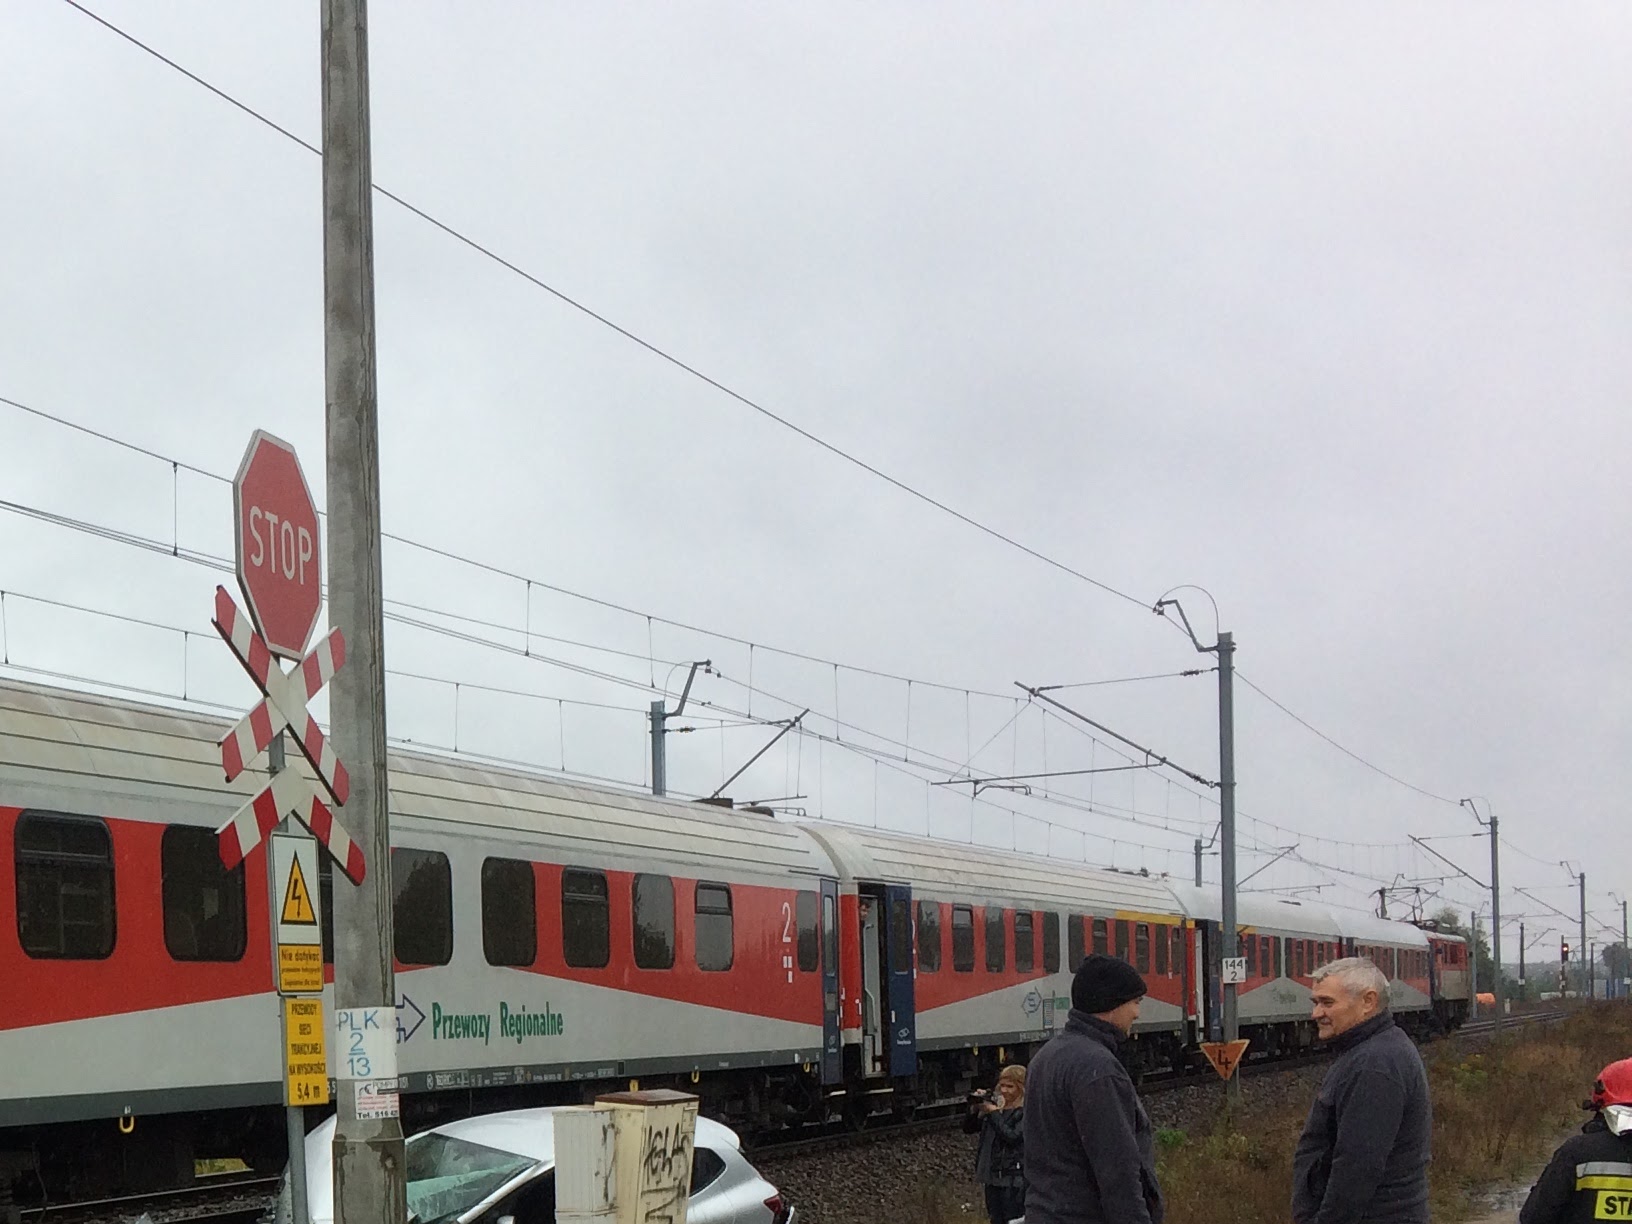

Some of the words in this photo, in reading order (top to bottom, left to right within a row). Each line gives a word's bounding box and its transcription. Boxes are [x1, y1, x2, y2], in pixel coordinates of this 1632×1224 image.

[249, 505, 312, 585] STOP
[782, 902, 792, 942] 2
[1225, 959, 1243, 970] 144
[1231, 971, 1238, 981] 2
[337, 1010, 379, 1031] PLK
[432, 1002, 490, 1046] Przewozy
[500, 1001, 563, 1044] Regionalne
[349, 1032, 364, 1052] 2
[347, 1057, 371, 1077] 13
[297, 1082, 310, 1101] 5,4
